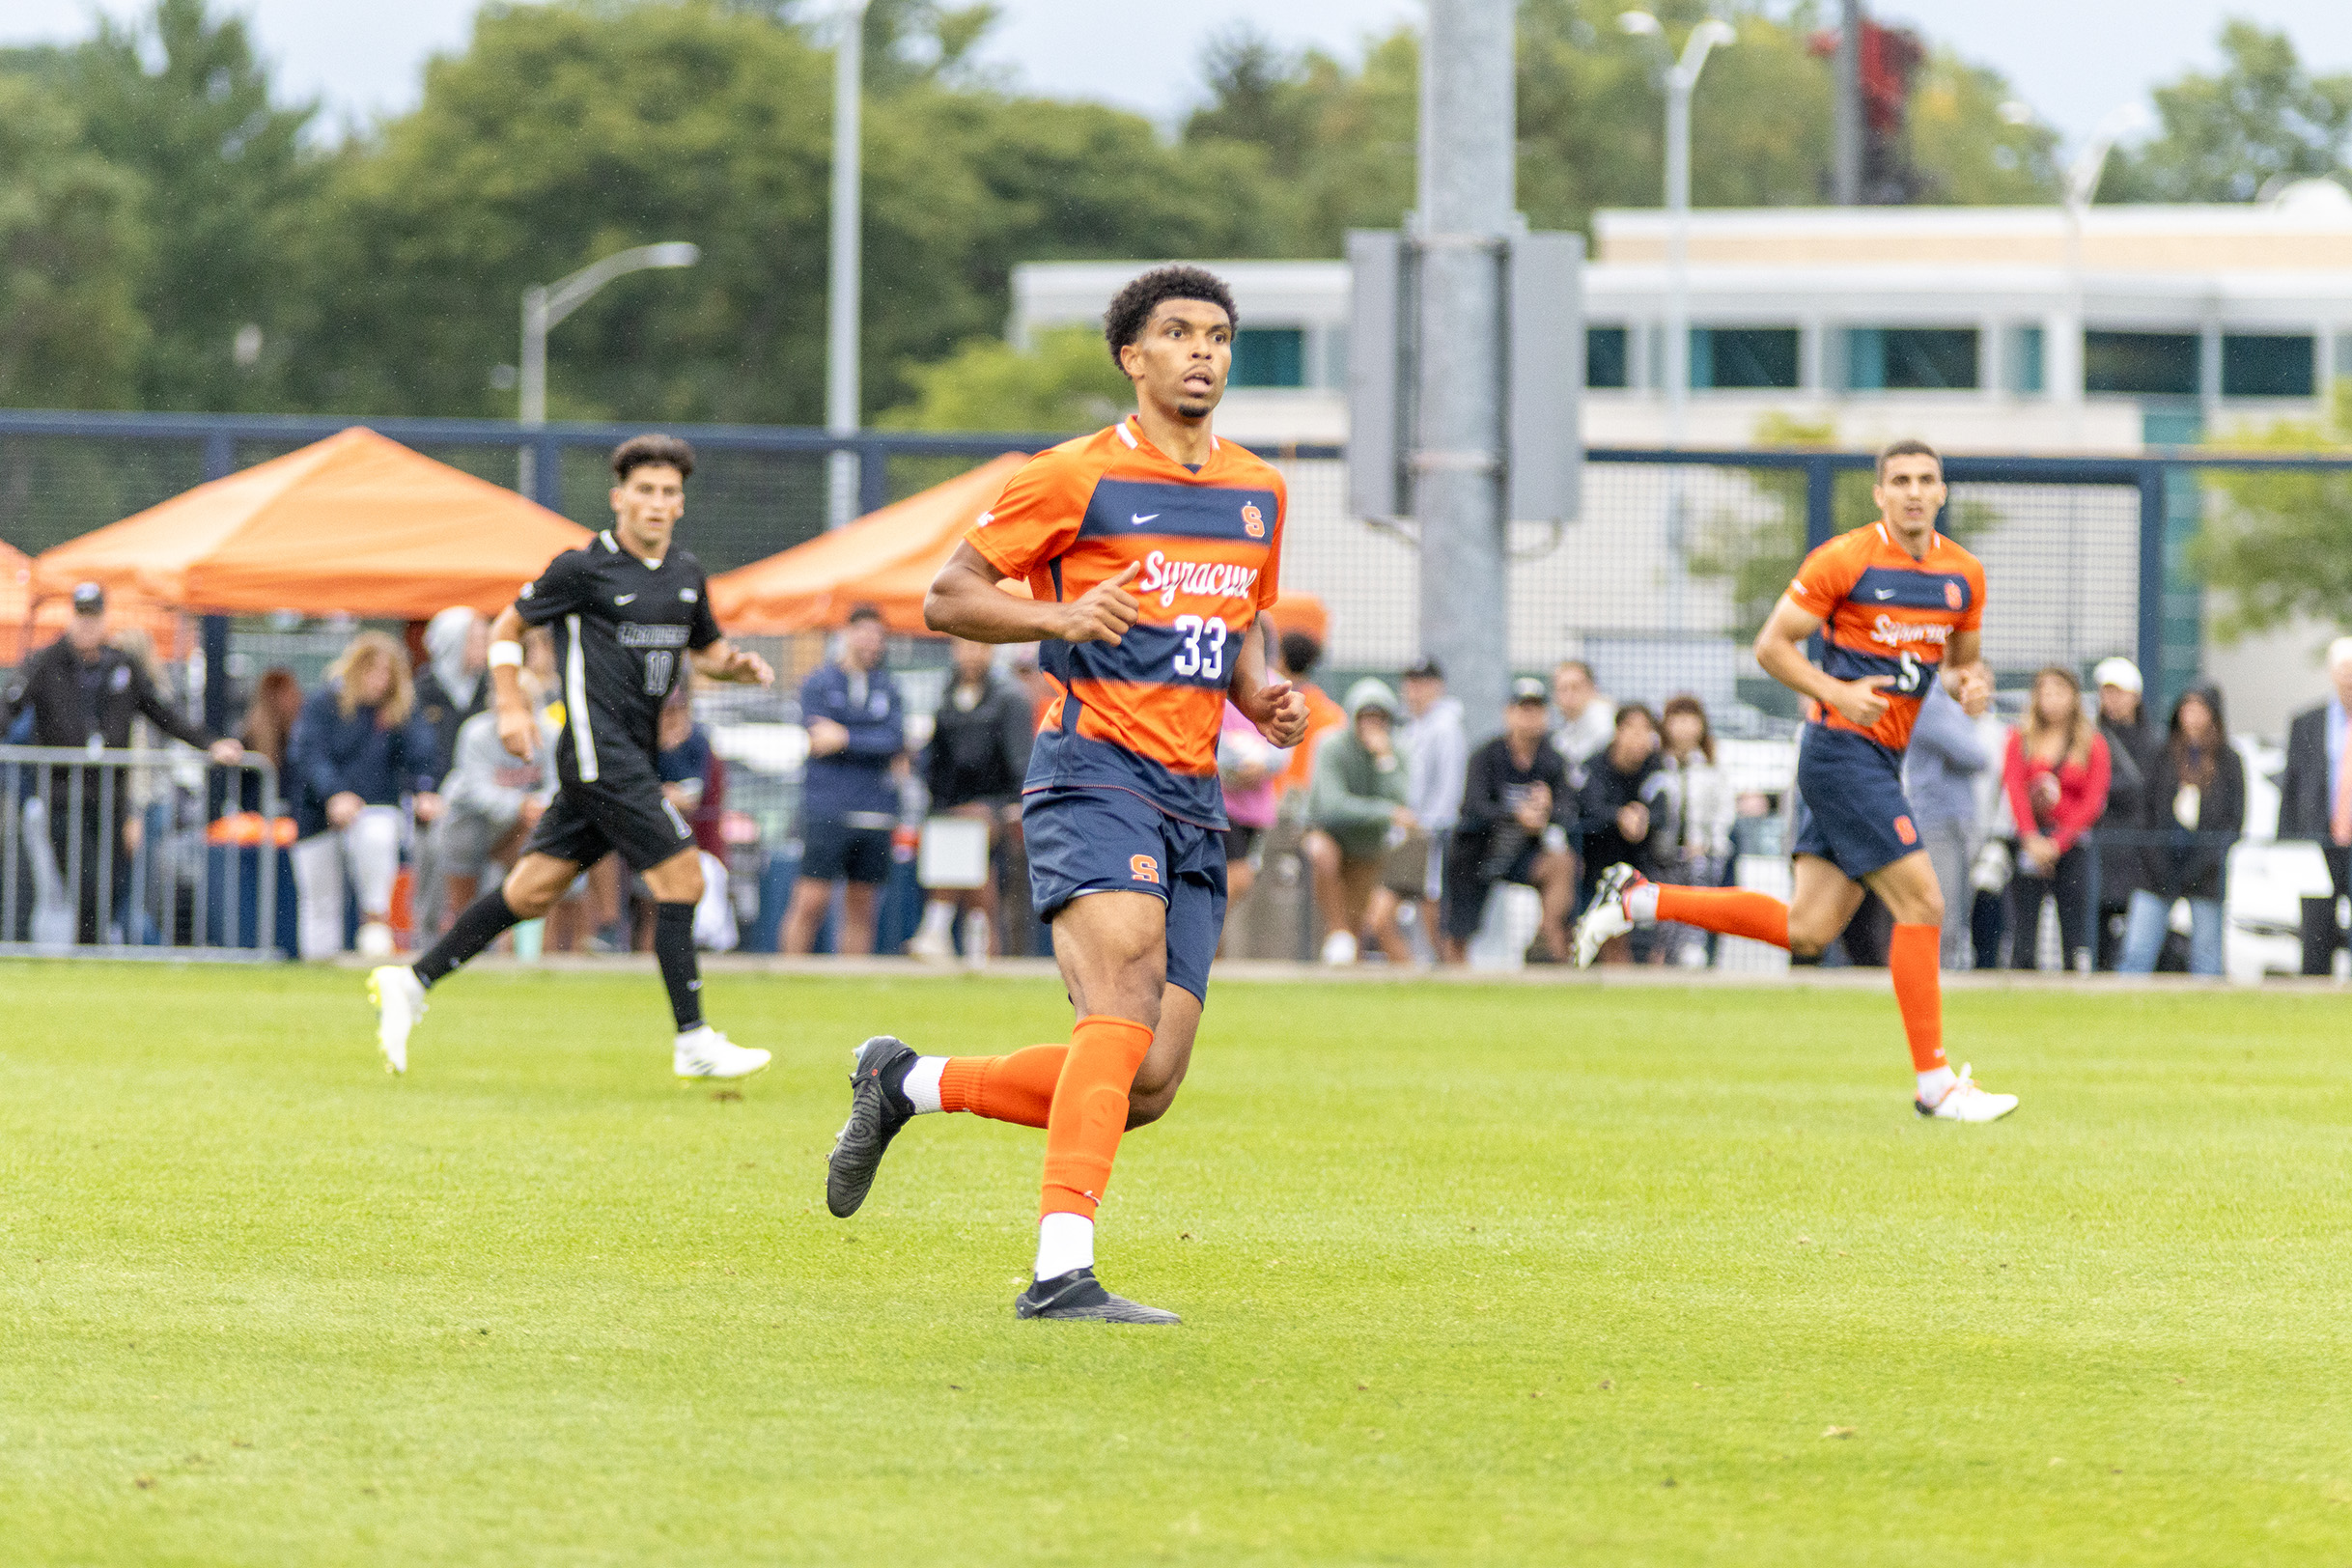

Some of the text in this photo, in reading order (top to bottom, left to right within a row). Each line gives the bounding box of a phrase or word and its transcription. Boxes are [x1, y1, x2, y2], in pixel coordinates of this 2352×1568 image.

[1242, 505, 1265, 538] S
[1140, 549, 1258, 608] Syracuse
[1173, 614, 1227, 680] 33
[1897, 650, 1920, 693] 5
[1130, 854, 1160, 884] S
